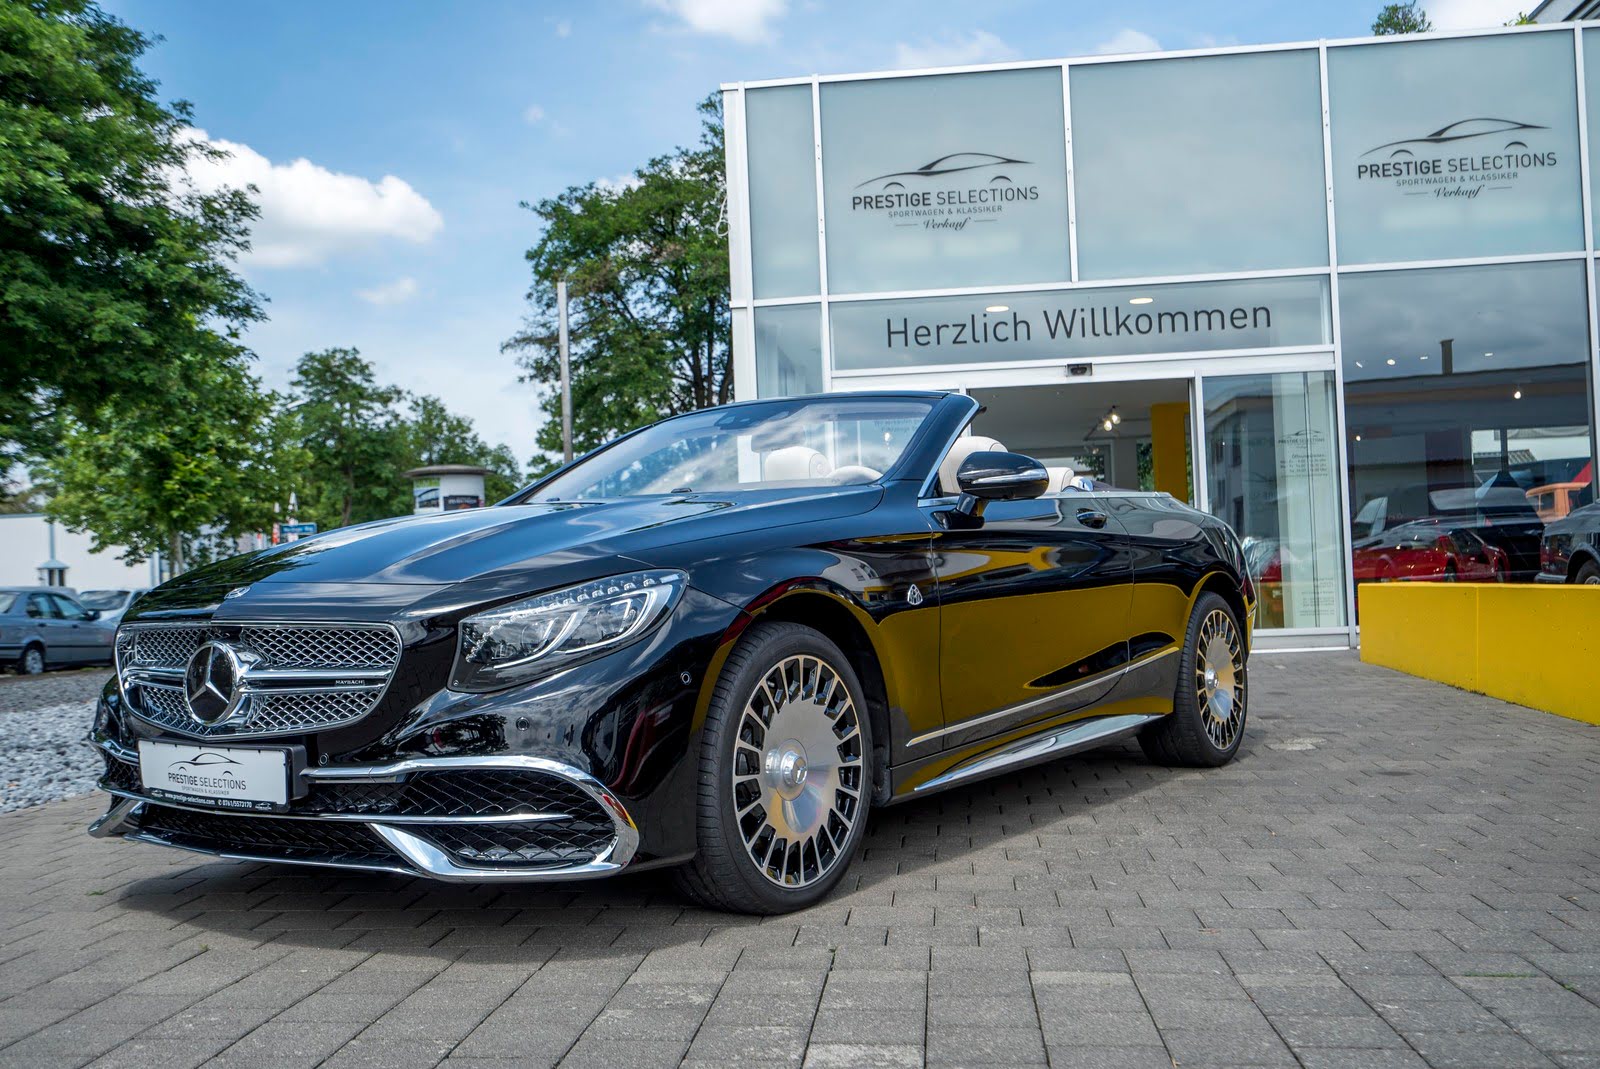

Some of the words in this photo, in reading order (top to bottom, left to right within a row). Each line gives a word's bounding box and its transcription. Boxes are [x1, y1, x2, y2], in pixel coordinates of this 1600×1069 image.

[1358, 159, 1442, 179] PRESTIGE
[1448, 152, 1557, 173] SELECTIONS
[1396, 176, 1456, 187] SPORTWAGEN
[1460, 175, 1466, 183] &
[1469, 172, 1518, 182] KLASSIKER
[852, 192, 931, 210] PRESTIGE
[936, 186, 1039, 205] SELECTIONS
[1434, 185, 1485, 199] Verkauf
[888, 209, 944, 218] SPORTWAGEN
[956, 205, 1002, 214] KLASSIKER
[923, 216, 971, 230] Verkauf
[887, 312, 1031, 348] Herzlich
[1043, 305, 1272, 339] Willkommen
[168, 772, 198, 786] PRESTIGE
[200, 777, 247, 791] SELECTIONS
